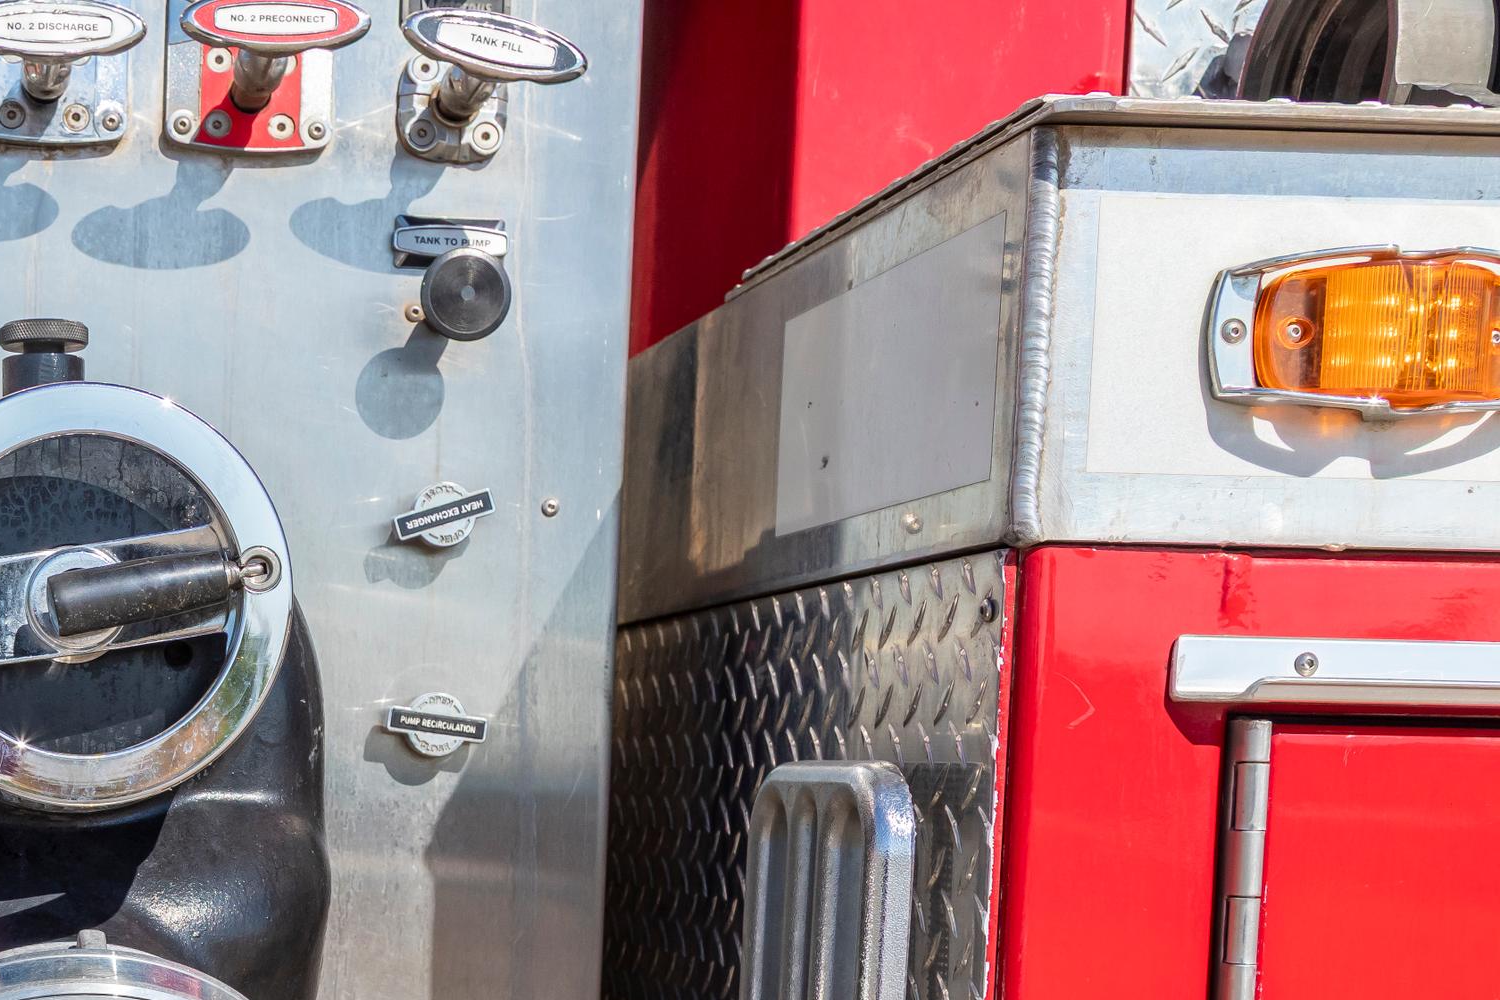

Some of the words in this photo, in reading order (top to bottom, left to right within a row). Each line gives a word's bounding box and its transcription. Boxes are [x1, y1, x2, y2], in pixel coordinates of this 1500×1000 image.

[230, 14, 247, 22] NO.
[250, 14, 257, 22] 2
[259, 14, 326, 24] PRECONNECT
[7, 22, 25, 30] NO.
[28, 22, 35, 30] 2
[38, 22, 99, 32] DISCHARGE
[470, 33, 499, 48] TANK
[501, 40, 524, 53] FILL
[414, 235, 441, 246] TANK
[444, 238, 458, 246] TO
[461, 239, 491, 247] PUMP
[461, 499, 484, 514] HEAT
[405, 506, 460, 530] EXCHANGER
[400, 715, 421, 726] PUMP
[422, 718, 477, 734] RECIRCULATION
